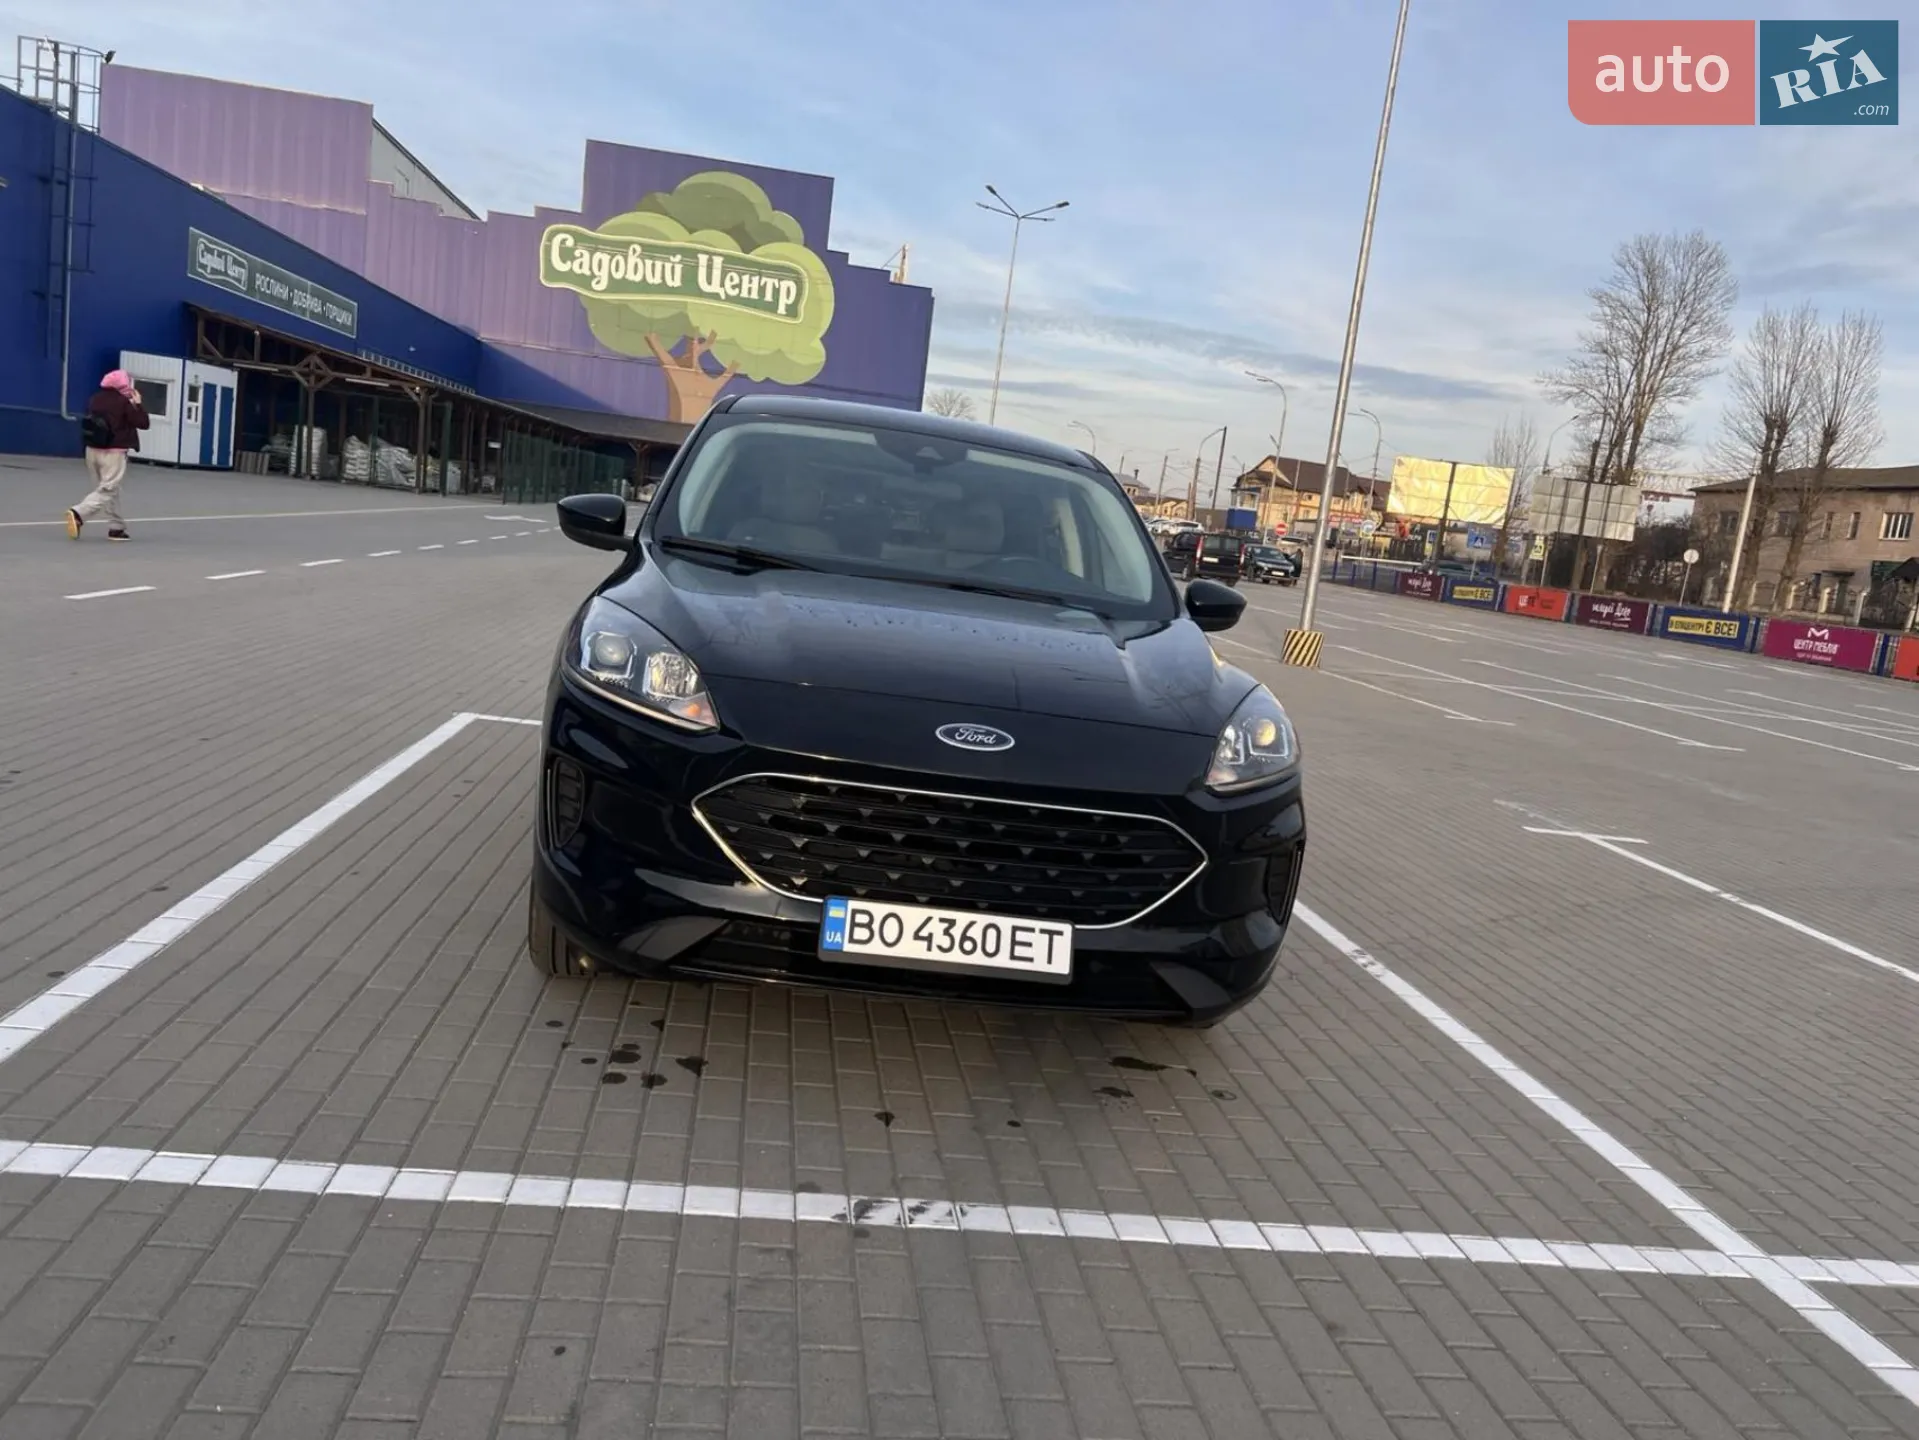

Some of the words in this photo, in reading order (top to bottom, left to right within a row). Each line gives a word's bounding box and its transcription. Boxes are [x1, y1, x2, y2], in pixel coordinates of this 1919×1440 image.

[551, 233, 683, 291] Садовий
[697, 253, 798, 315] Центр
[255, 273, 289, 301] РОСЛИНИ
[292, 289, 323, 315] ДОБРИВА
[325, 302, 353, 326] ГОРЩИКИ
[1714, 621, 1738, 636] ВСЕ!
[955, 727, 997, 744] Ford
[826, 931, 843, 944] UA
[848, 908, 904, 948] BO
[913, 916, 1002, 959] 4360
[1009, 924, 1065, 965] ET
